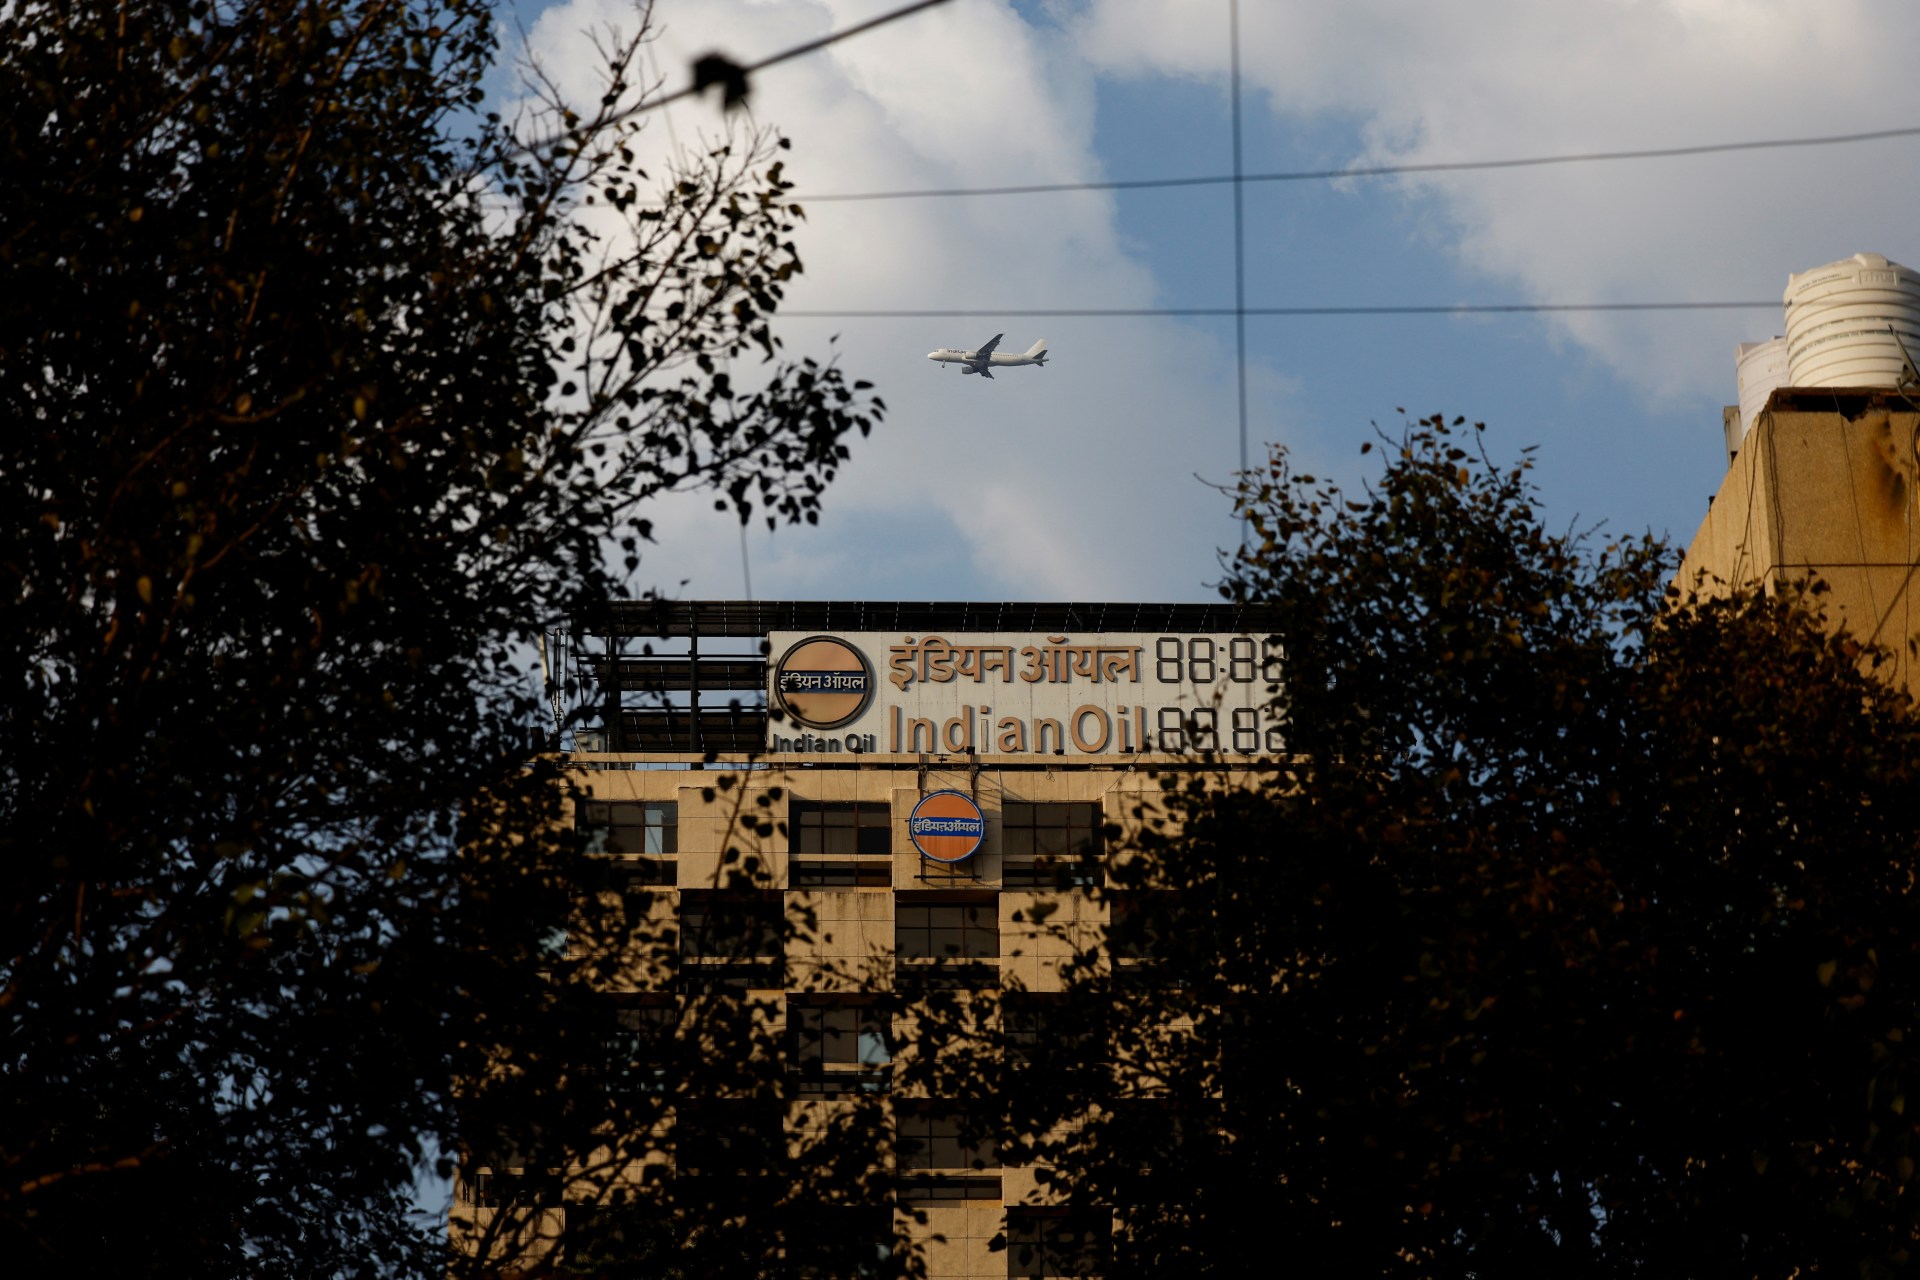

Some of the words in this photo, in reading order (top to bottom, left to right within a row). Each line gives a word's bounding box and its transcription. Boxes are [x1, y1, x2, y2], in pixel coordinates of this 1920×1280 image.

[823, 671, 866, 689] ऑयल
[889, 634, 1015, 692] इंडियन
[1020, 635, 1143, 684] ऑयल
[773, 733, 841, 753] Indian
[845, 733, 876, 754] Oil
[890, 704, 1063, 755] Indian
[1070, 704, 1148, 755] Oil
